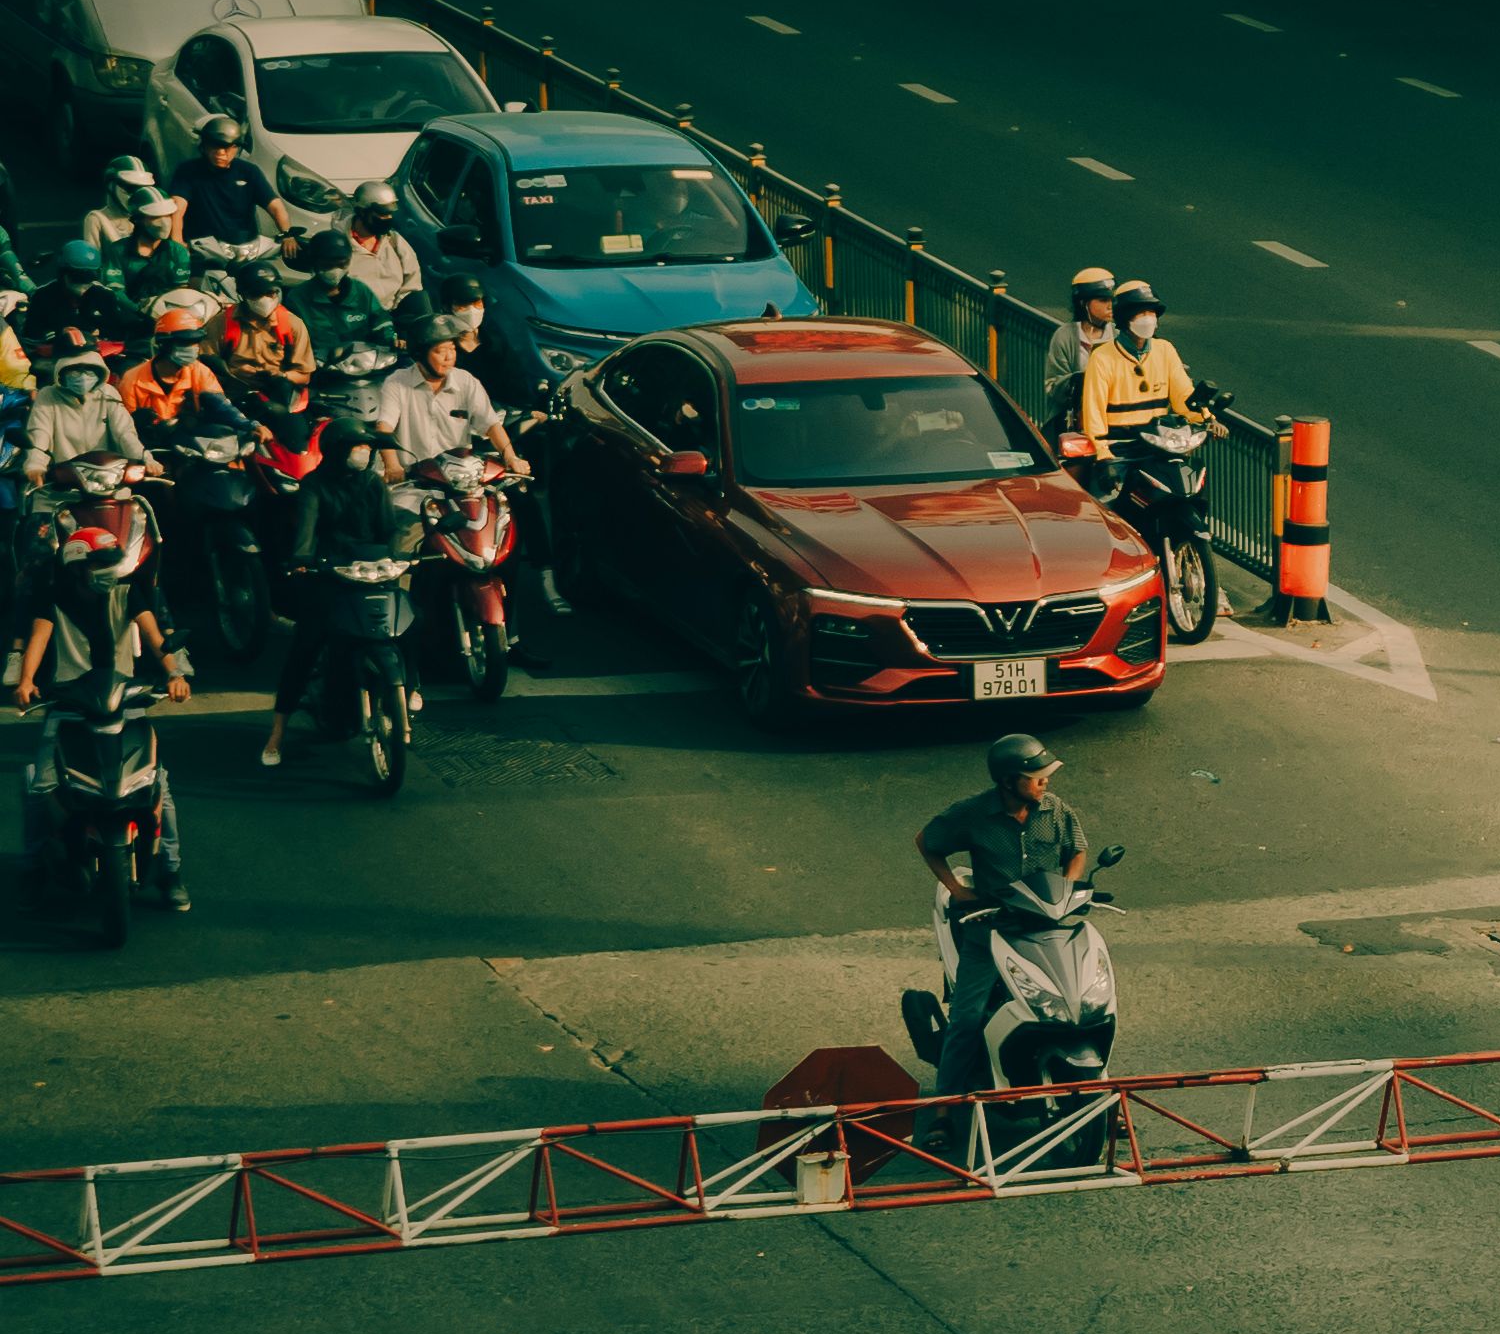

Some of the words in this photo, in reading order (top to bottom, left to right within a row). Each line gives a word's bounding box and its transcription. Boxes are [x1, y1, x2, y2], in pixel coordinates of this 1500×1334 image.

[521, 196, 557, 205] TAXI
[995, 662, 1025, 678] 51H
[983, 678, 1036, 696] 978.01
